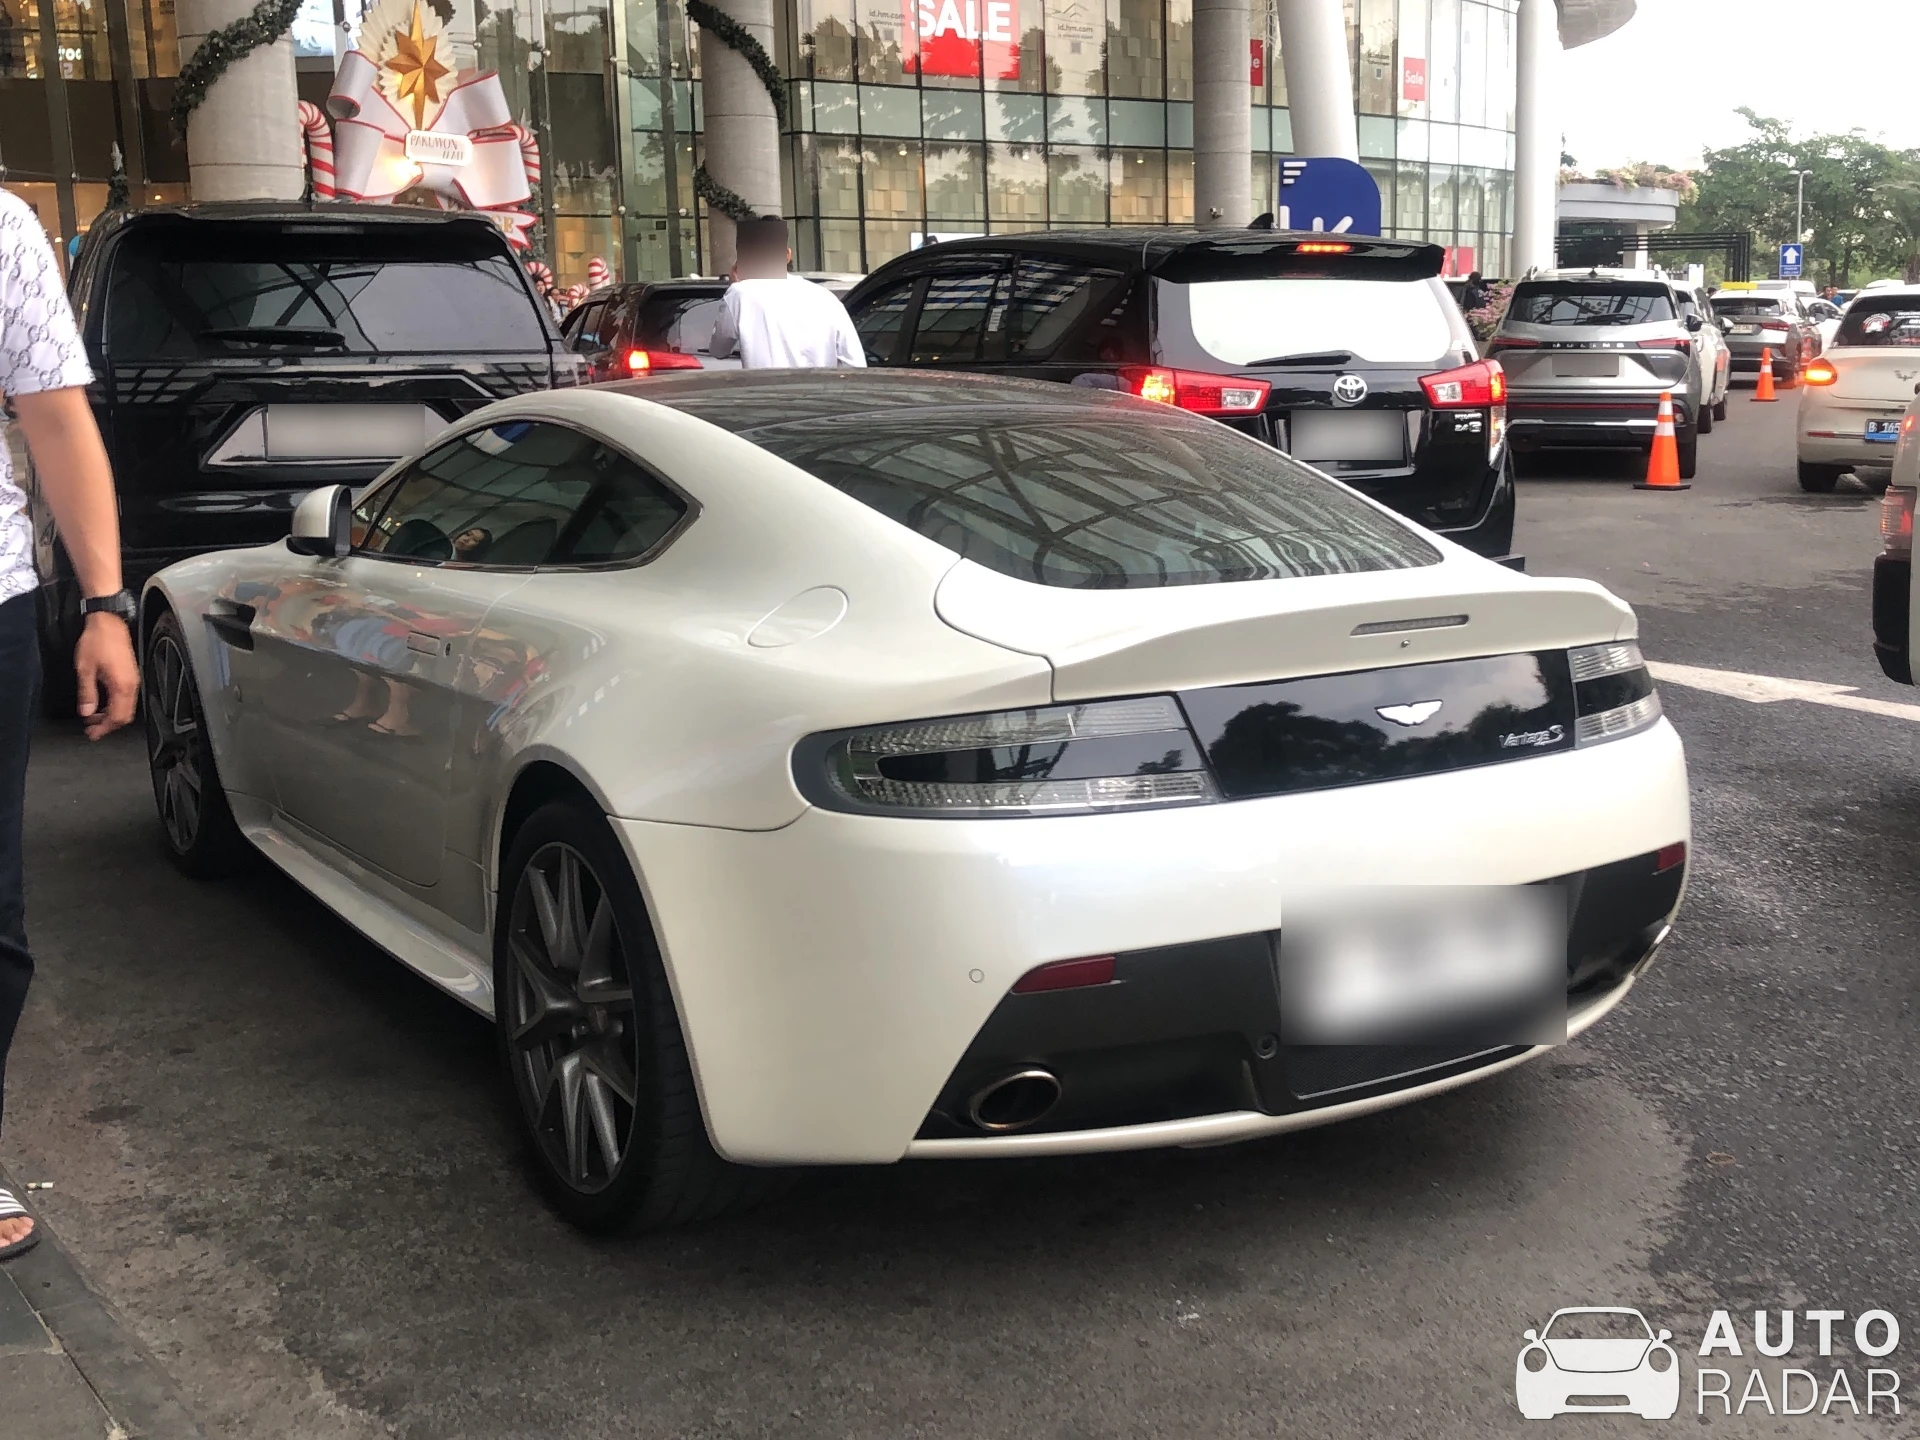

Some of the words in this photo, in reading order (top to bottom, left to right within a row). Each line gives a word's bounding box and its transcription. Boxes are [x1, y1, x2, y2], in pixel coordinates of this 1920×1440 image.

[910, 0, 1011, 41] SALE
[1057, 24, 1093, 32] id.hm.com
[1405, 69, 1425, 85] Sale
[410, 135, 458, 150] PAKUWON
[1498, 730, 1550, 749] Vantage
[1533, 724, 1565, 746] S
